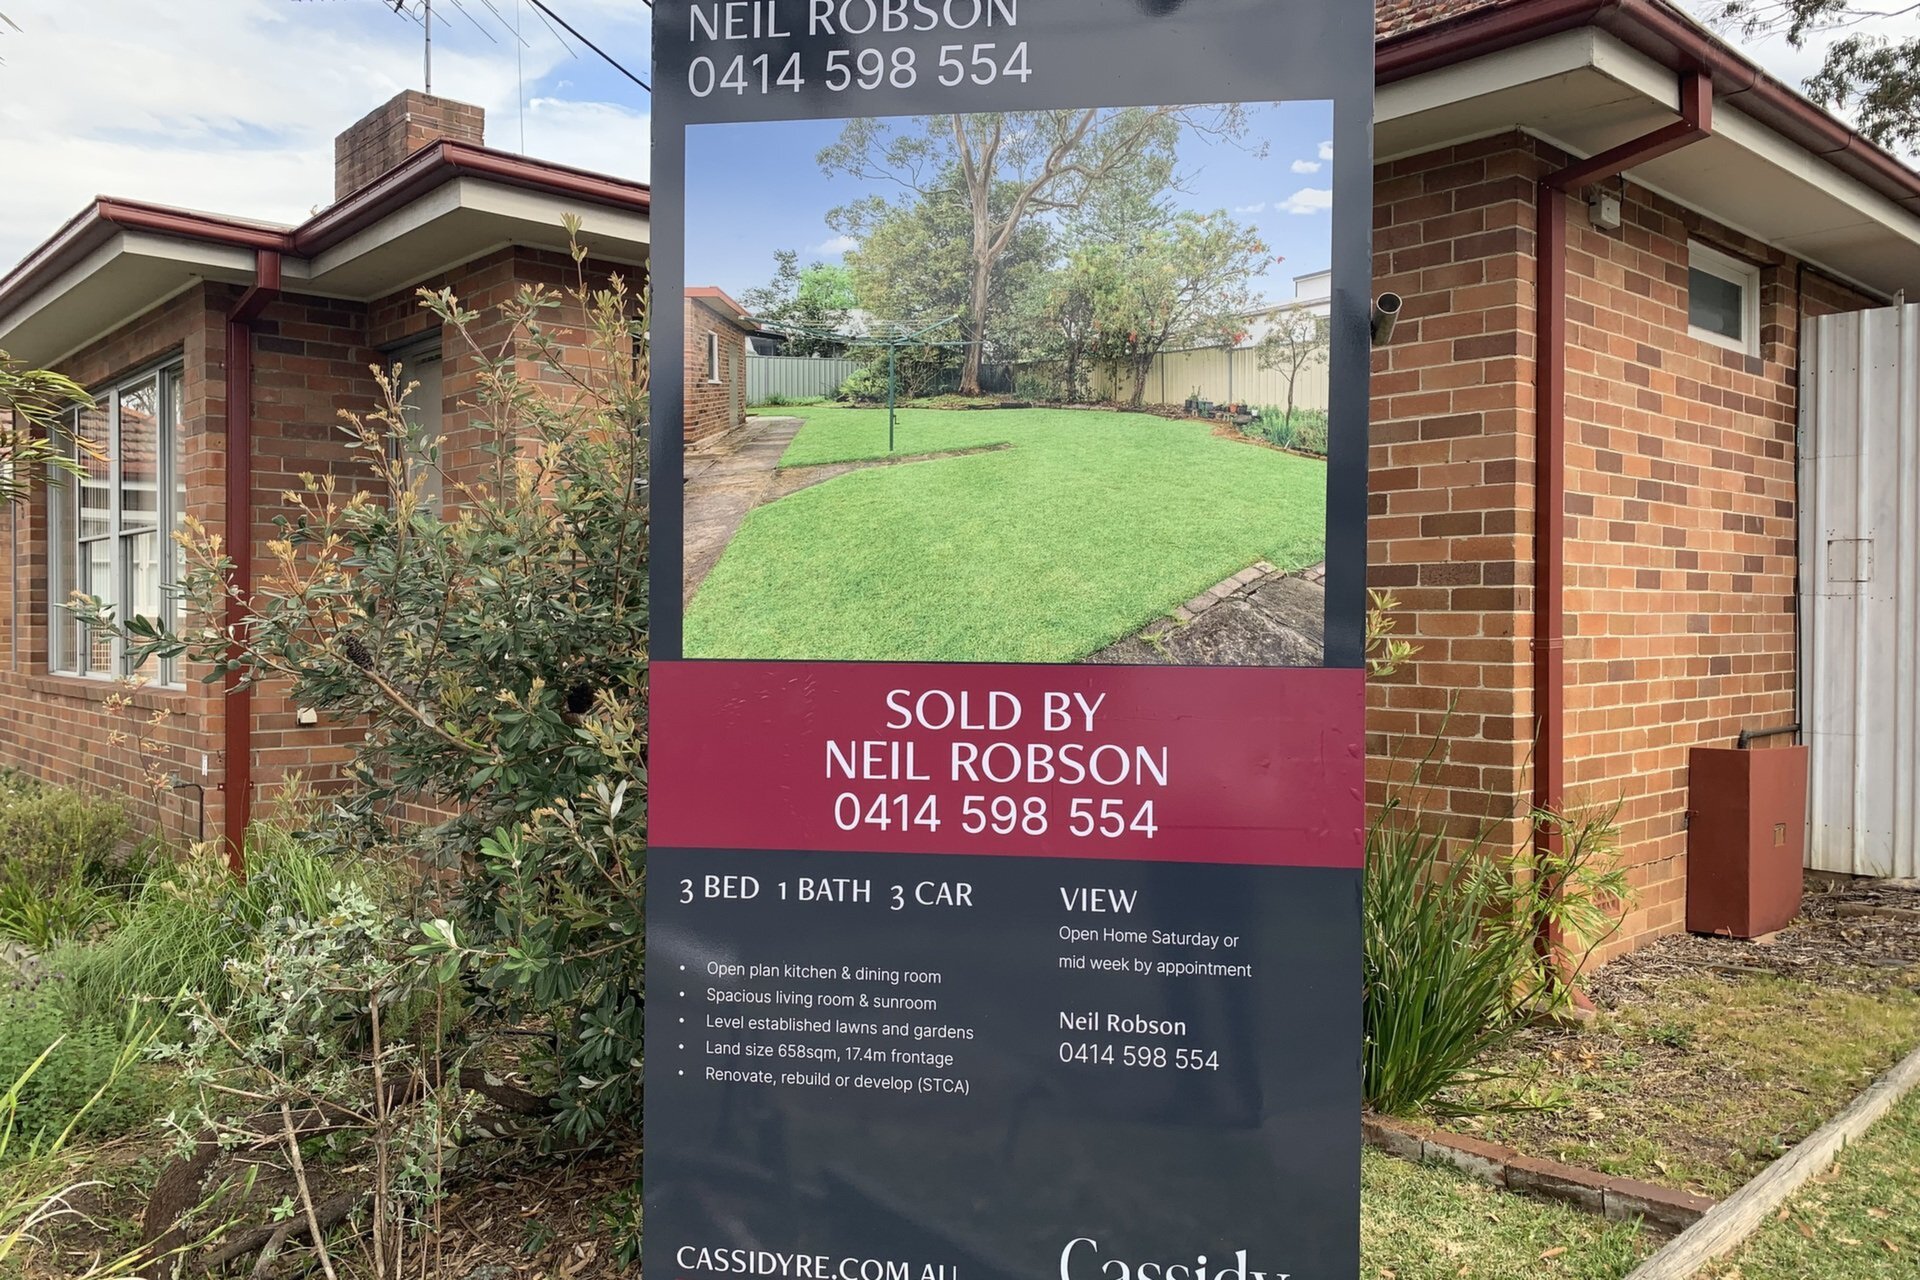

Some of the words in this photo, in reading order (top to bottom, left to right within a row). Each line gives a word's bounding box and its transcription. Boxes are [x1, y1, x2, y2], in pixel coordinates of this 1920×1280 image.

[690, 0, 791, 42] NEIL
[809, 0, 1017, 36] ROBSON
[688, 52, 805, 98] 0414
[825, 46, 917, 92] 598
[938, 41, 1033, 87] 554
[886, 689, 1022, 731] SOLD
[1044, 691, 1106, 732] BY
[826, 739, 931, 781] NEIL
[951, 742, 1168, 786] ROBSON
[834, 792, 941, 833] 0414
[961, 795, 1048, 836] 598
[1069, 797, 1158, 839] 554
[679, 878, 694, 904] 3
[704, 874, 760, 899] BED
[778, 881, 786, 900] 1
[798, 877, 871, 903] BATH
[890, 885, 905, 911] 3
[914, 881, 973, 907] CAR
[1059, 887, 1138, 914] VIEW
[1059, 925, 1099, 944] Open
[1103, 927, 1148, 944] Home
[1151, 929, 1220, 950] Saturday
[1223, 936, 1240, 948] or
[706, 960, 745, 978] Open
[749, 963, 780, 980] plan
[784, 964, 837, 979] kitchen
[841, 965, 852, 980] &
[855, 966, 900, 986] dining
[904, 971, 942, 984] room
[1059, 954, 1086, 969] mid
[1089, 957, 1130, 972] week
[1134, 957, 1153, 976] by
[1156, 960, 1252, 978] appointment
[706, 987, 772, 1005] Spacious
[776, 990, 813, 1009] living
[817, 994, 855, 1007] room
[859, 993, 869, 1008] &
[873, 996, 937, 1011] sunroom
[706, 1014, 744, 1029] Level
[748, 1017, 831, 1033] established
[835, 1019, 878, 1035] lawns
[881, 1022, 909, 1037] and
[913, 1024, 974, 1041] gardens
[1059, 1011, 1099, 1031] Neil
[1107, 1013, 1186, 1036] Robson
[706, 1040, 741, 1056] Land
[745, 1042, 774, 1057] size
[778, 1043, 841, 1063] 658sqm,
[845, 1046, 887, 1062] 17.4m
[891, 1048, 954, 1069] frontage
[1059, 1041, 1115, 1065] 0414
[1123, 1045, 1167, 1068] 598
[1175, 1048, 1220, 1071] 554
[705, 1066, 777, 1087] Renovate,
[781, 1071, 831, 1087] rebuild
[834, 1075, 851, 1087] or
[853, 1074, 913, 1094] develop
[917, 1076, 970, 1096] (STCA)
[676, 1245, 957, 1280] CASSIDYRE.COMAU
[1060, 1237, 1291, 1280] Caid
